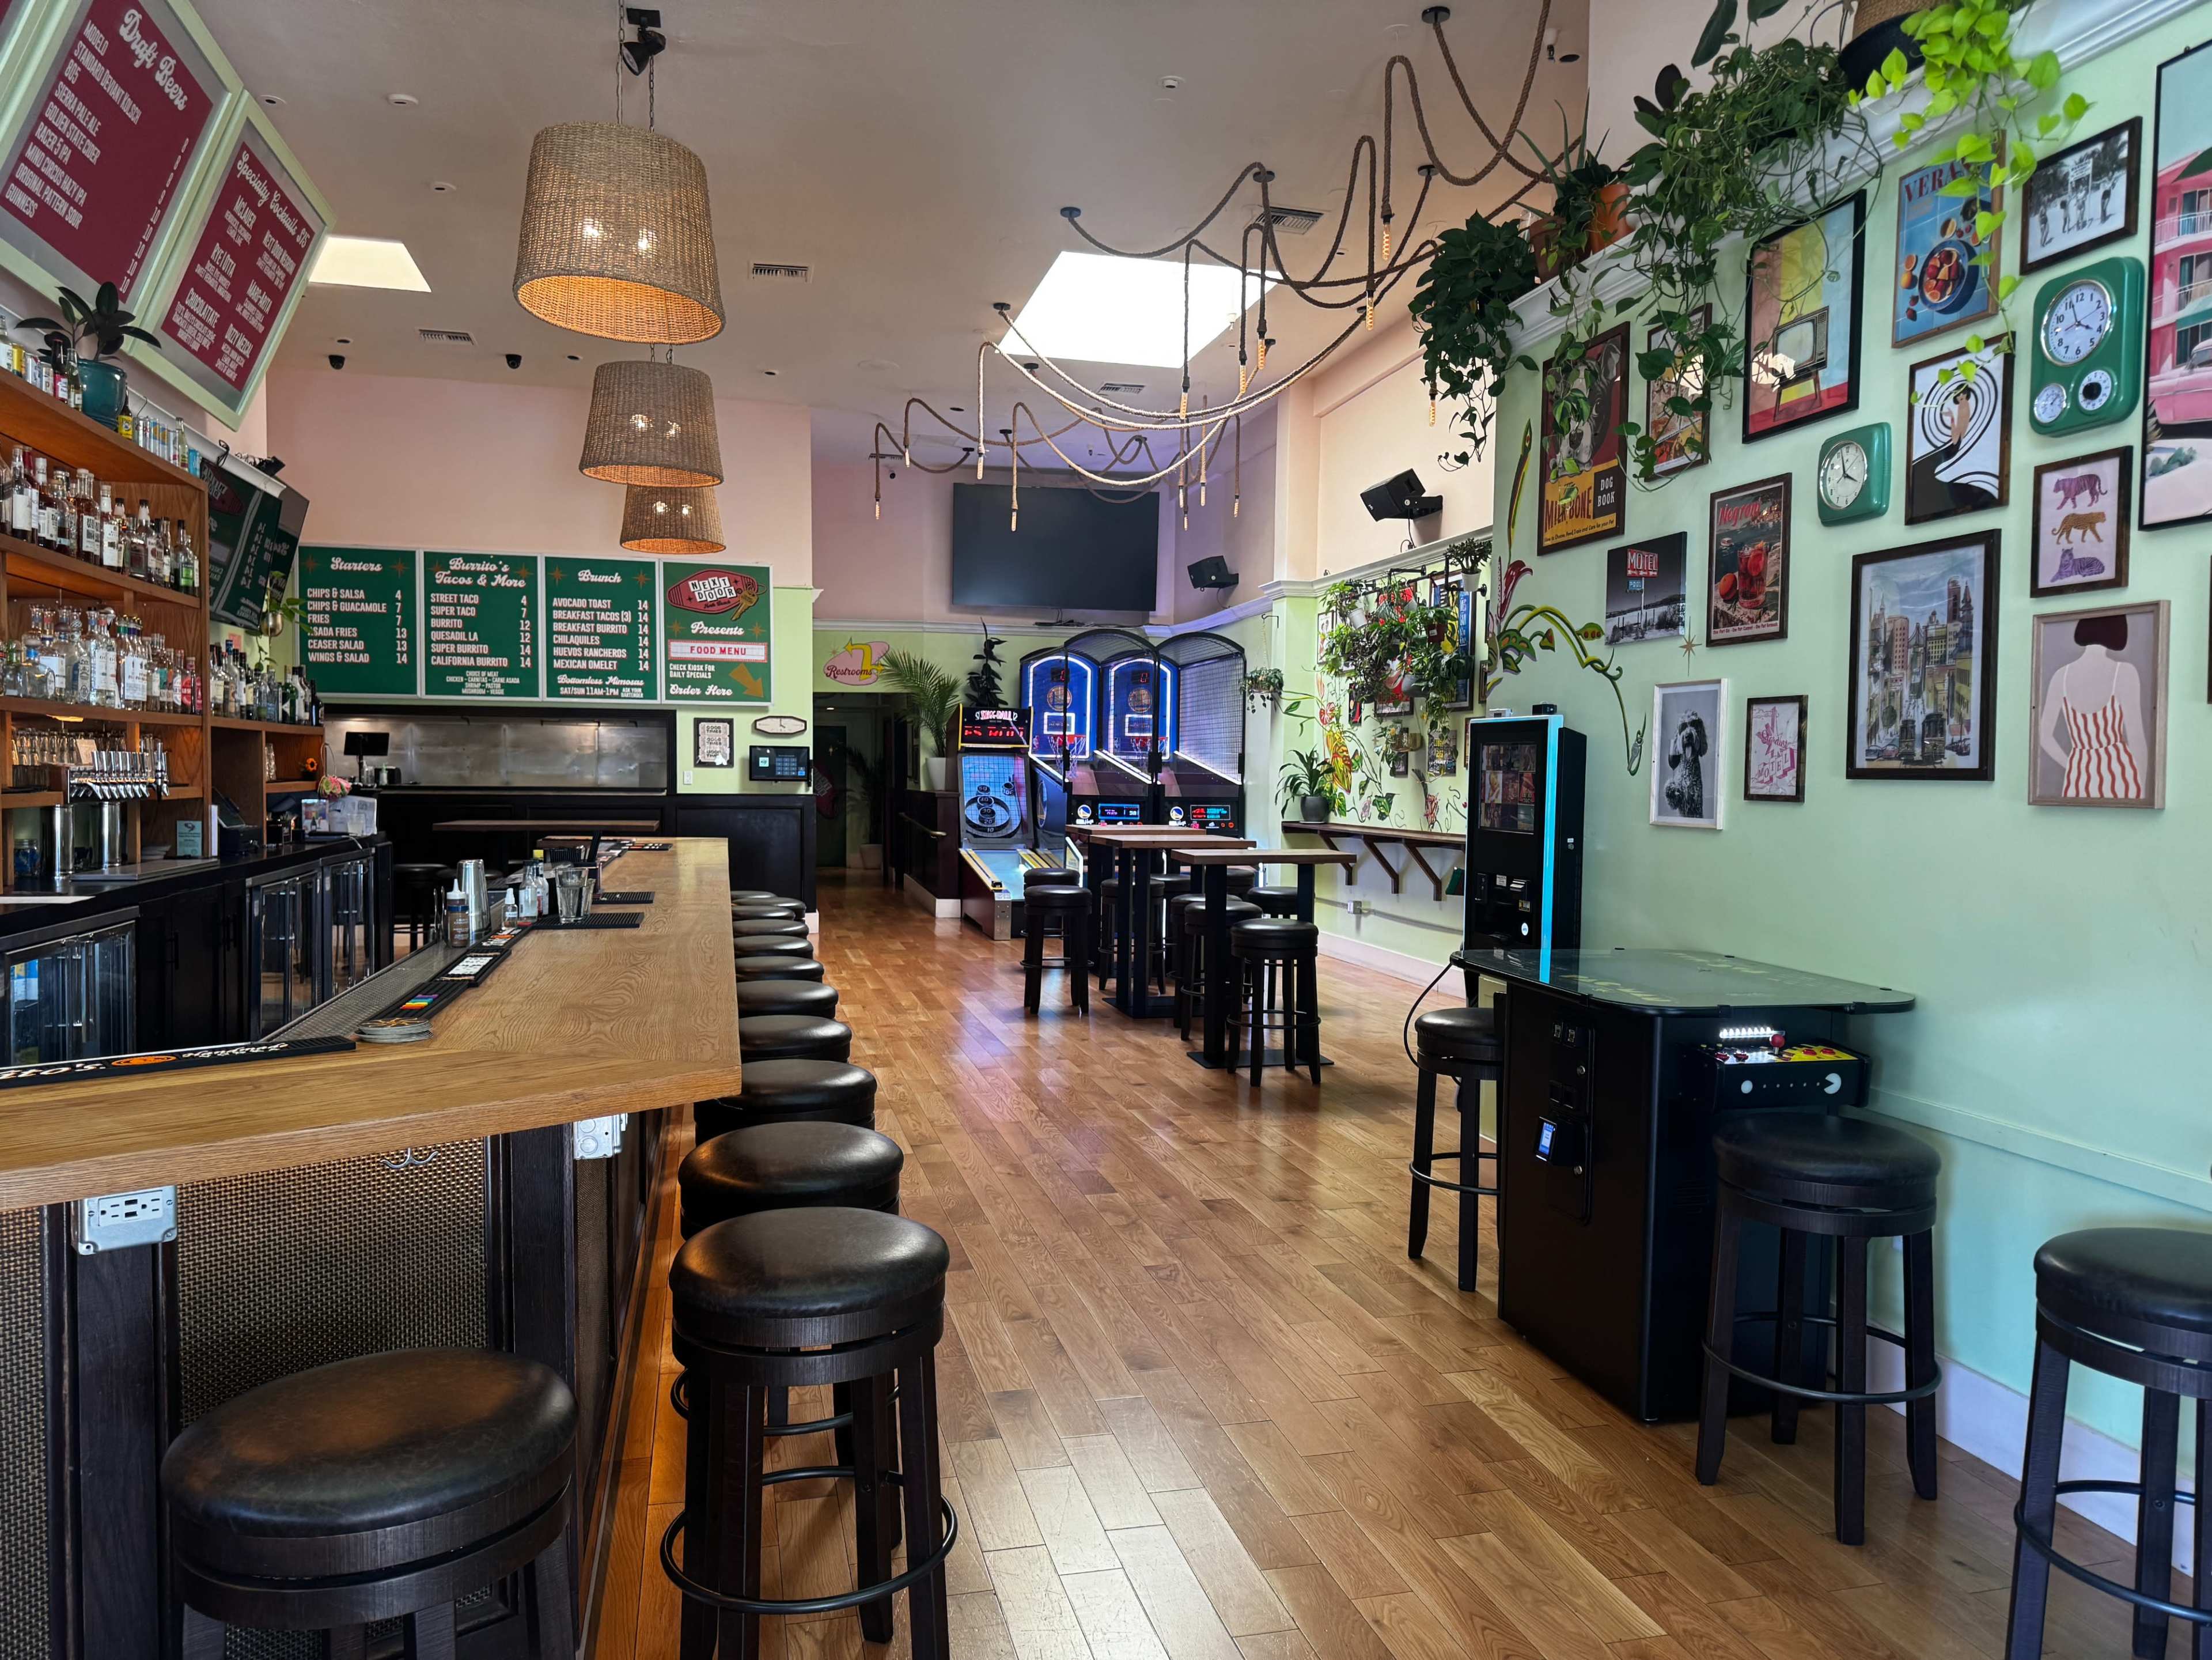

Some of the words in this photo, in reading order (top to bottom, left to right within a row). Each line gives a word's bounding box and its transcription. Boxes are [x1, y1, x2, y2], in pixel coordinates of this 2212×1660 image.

[84, 20, 108, 55] MODELO
[74, 41, 104, 81] STANDARD
[119, 9, 158, 68] Draft
[155, 56, 187, 110] Beers
[65, 59, 81, 84] 805
[55, 82, 77, 112] SIERRA
[74, 102, 92, 126] PALE
[87, 116, 101, 136] ALE
[35, 122, 58, 151] RACER
[46, 102, 70, 133] GOLDEN
[66, 123, 86, 150] STATE
[82, 139, 100, 164] CIDER
[54, 138, 63, 154] 5
[58, 145, 71, 164] IPA
[25, 142, 45, 167] MIND
[41, 157, 65, 185] CIRCUS
[60, 175, 78, 197] HAZY
[74, 188, 87, 206] IPA
[16, 163, 44, 196] ORIGINAL
[41, 186, 69, 217] PATTERN
[65, 206, 82, 229] SOUR
[237, 151, 270, 207] Specialty
[270, 191, 298, 235] Cocktails
[6, 183, 37, 217] GUINNESS
[2076, 293, 2084, 302] 12
[2090, 293, 2093, 301] 1
[2065, 300, 2072, 310] 11
[2096, 300, 2101, 309] 2
[2056, 314, 2065, 323] 10
[2100, 312, 2105, 321] 3
[2097, 324, 2102, 333] 4
[2058, 338, 2063, 347] 8
[2089, 337, 2095, 346] 5
[2064, 346, 2069, 354] 7
[2075, 346, 2081, 355] 6
[1600, 476, 1613, 491] DOG
[1597, 491, 1615, 507] BOOK
[331, 557, 382, 571] Starters
[1628, 551, 1658, 571] MOTEL
[435, 570, 473, 584] Tacos
[477, 574, 486, 586] &
[491, 574, 525, 587] More
[578, 570, 622, 583] Brunch
[692, 578, 726, 591] NEXT
[308, 588, 330, 598] CHIPS
[332, 588, 338, 598] &
[340, 589, 365, 599] SALSA
[396, 590, 401, 600] 4
[431, 593, 458, 603] STREET
[460, 594, 479, 604] TACO
[521, 596, 527, 605] 4
[699, 588, 734, 601] DOOR
[308, 601, 330, 611] CHIPS
[332, 600, 338, 611] &
[340, 602, 386, 612] GUACAMOLE
[396, 603, 401, 612] 7
[553, 598, 586, 608] AVOCADO
[588, 599, 611, 608] TOAST
[638, 600, 648, 610] 14
[431, 606, 454, 615] SUPER
[456, 607, 475, 616] TACO
[522, 608, 527, 618] 7
[553, 610, 594, 620] BREAKFAST
[596, 612, 619, 621] TACOS
[622, 611, 631, 622] (3)
[638, 612, 648, 622] 14
[308, 614, 329, 623] FRIES
[396, 615, 401, 625] 7
[431, 618, 462, 628] BURRITO
[520, 621, 530, 630] 12
[336, 627, 357, 637] FRIES
[396, 628, 406, 638] 13
[554, 622, 594, 632] BREAKFAST
[597, 624, 627, 633] BURRITO
[639, 625, 648, 634] 14
[691, 621, 744, 635] Presents
[521, 633, 530, 642] 12
[554, 635, 600, 645] CHILAQUILES
[639, 637, 649, 646] 14
[308, 640, 337, 649] CEASER
[339, 640, 363, 649] SALAD
[397, 641, 407, 651] 13
[431, 644, 455, 653] SUPER
[457, 644, 488, 653] BURRITO
[521, 645, 531, 655] 14
[690, 646, 716, 655] FOOD
[719, 646, 747, 656] MENU
[308, 652, 335, 661] WINGS
[337, 652, 342, 661] &
[344, 653, 369, 663] SALAD
[397, 653, 407, 663] 14
[554, 647, 582, 656] HUEVOS
[584, 648, 626, 658] RANCHEROS
[639, 649, 649, 659] 14
[431, 656, 475, 665] CALIFORNIA
[476, 657, 507, 667] BURRITO
[521, 657, 531, 667] 14
[554, 660, 586, 668] MEXICAN
[589, 660, 617, 670] OMELET
[639, 661, 649, 671] 14
[825, 665, 872, 679] Restrooms
[558, 674, 603, 685] Bottomless
[605, 676, 644, 686] Mimosas
[670, 684, 701, 695] Order
[705, 685, 732, 695] Here
[1758, 753, 1789, 778] MOTEL
